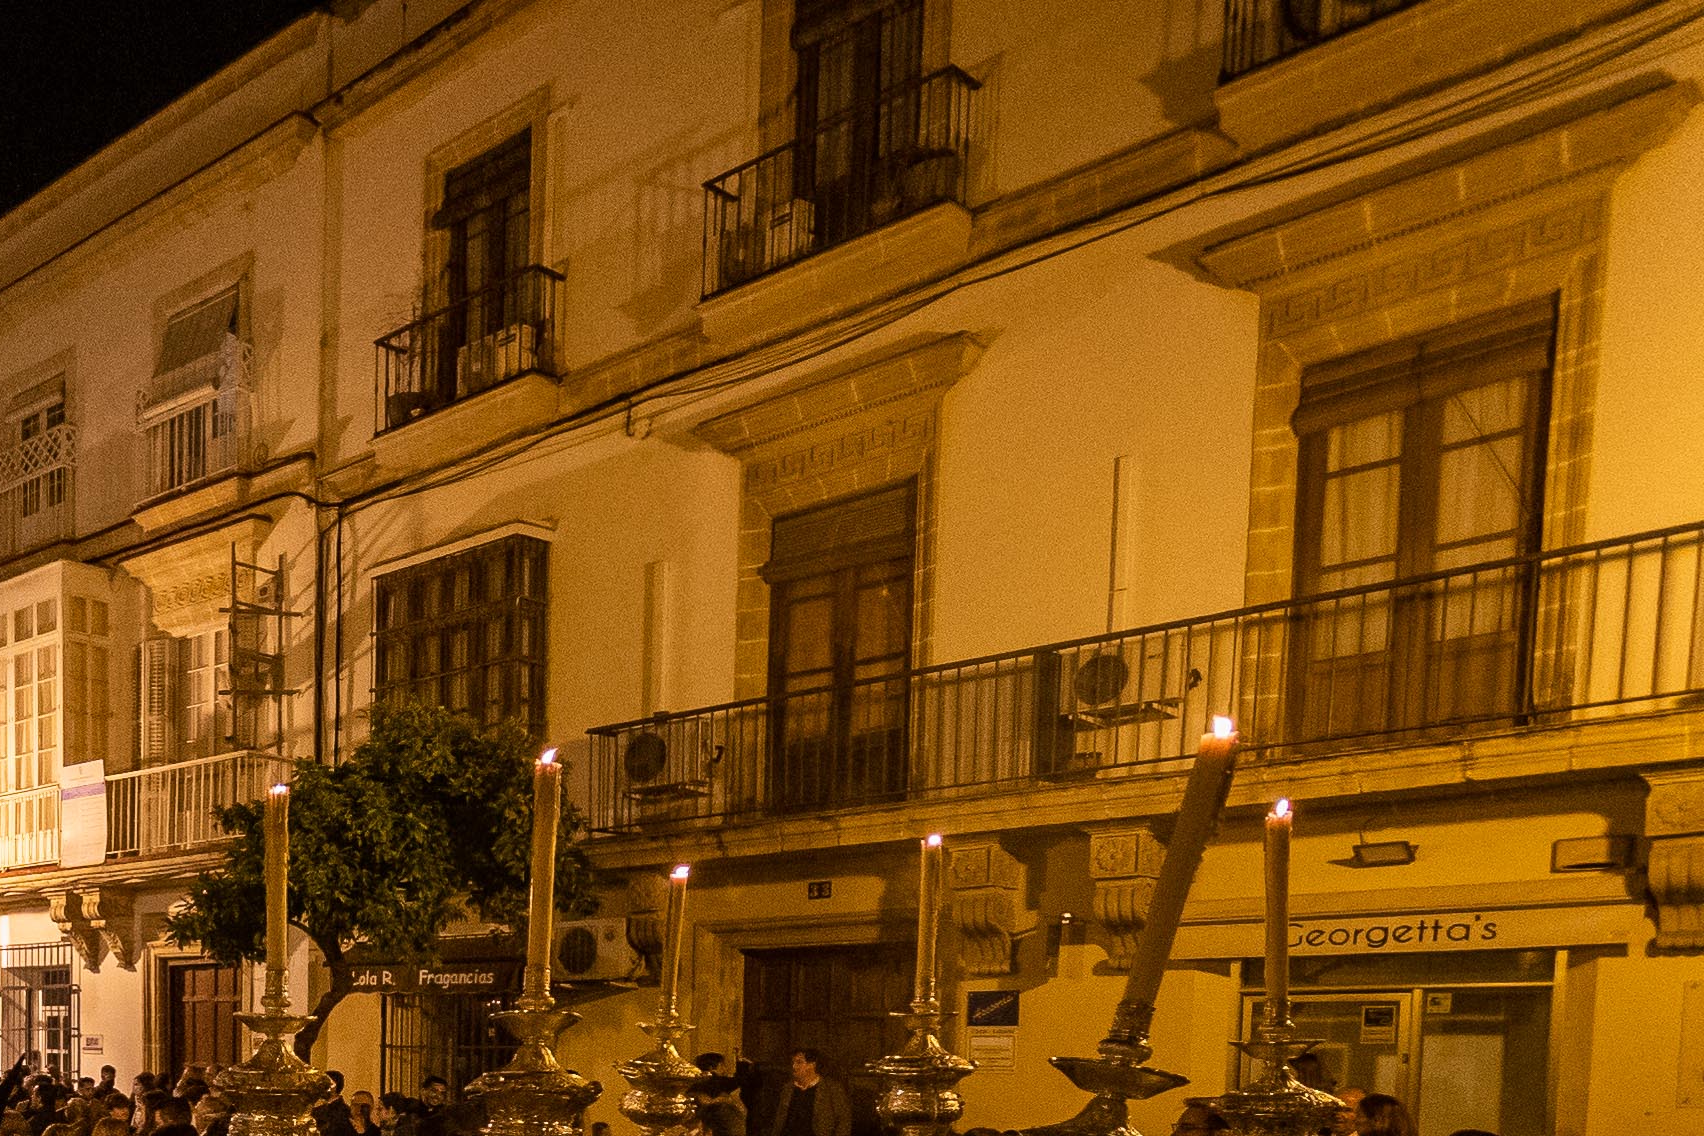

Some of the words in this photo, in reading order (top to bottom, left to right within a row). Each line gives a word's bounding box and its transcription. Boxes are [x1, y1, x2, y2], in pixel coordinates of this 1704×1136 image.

[1288, 914, 1497, 949] Georgetta's
[382, 970, 396, 986] R.
[418, 968, 495, 989] Fragancias
